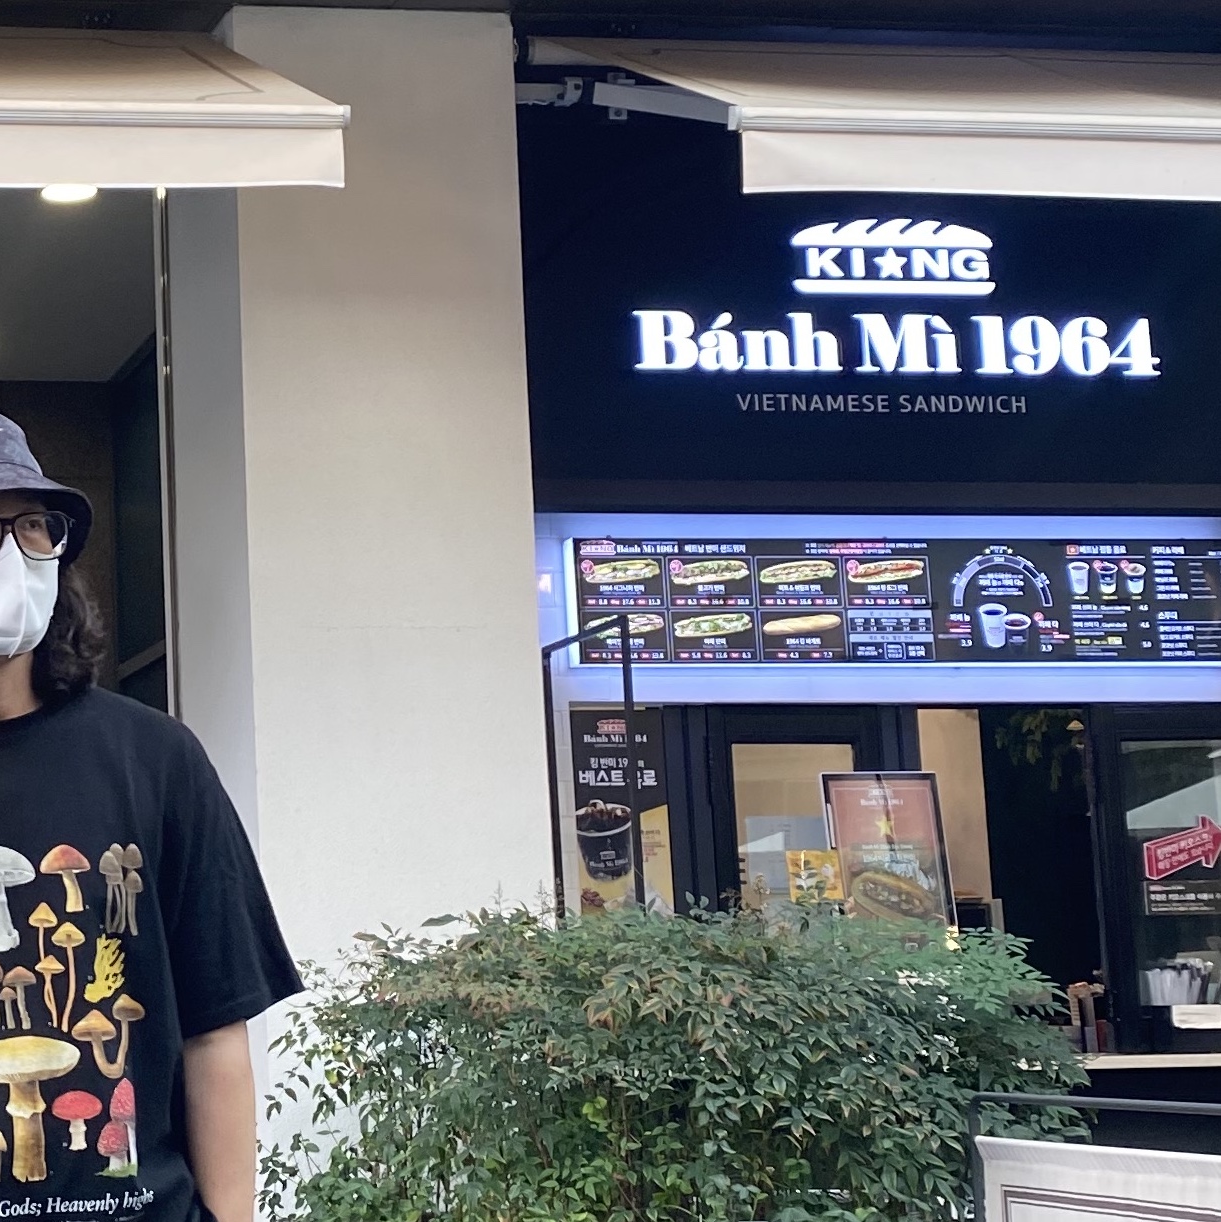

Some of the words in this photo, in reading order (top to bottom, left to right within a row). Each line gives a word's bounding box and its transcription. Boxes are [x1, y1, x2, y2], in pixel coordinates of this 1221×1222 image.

[631, 310, 844, 372] Bánh
[851, 312, 963, 373] Mì
[970, 315, 1162, 376] 1964
[736, 393, 890, 413] VIETNAMESE
[899, 394, 1027, 414] SANDWICH
[578, 769, 626, 787] 베스트
[46, 1192, 120, 1215] Heavenly
